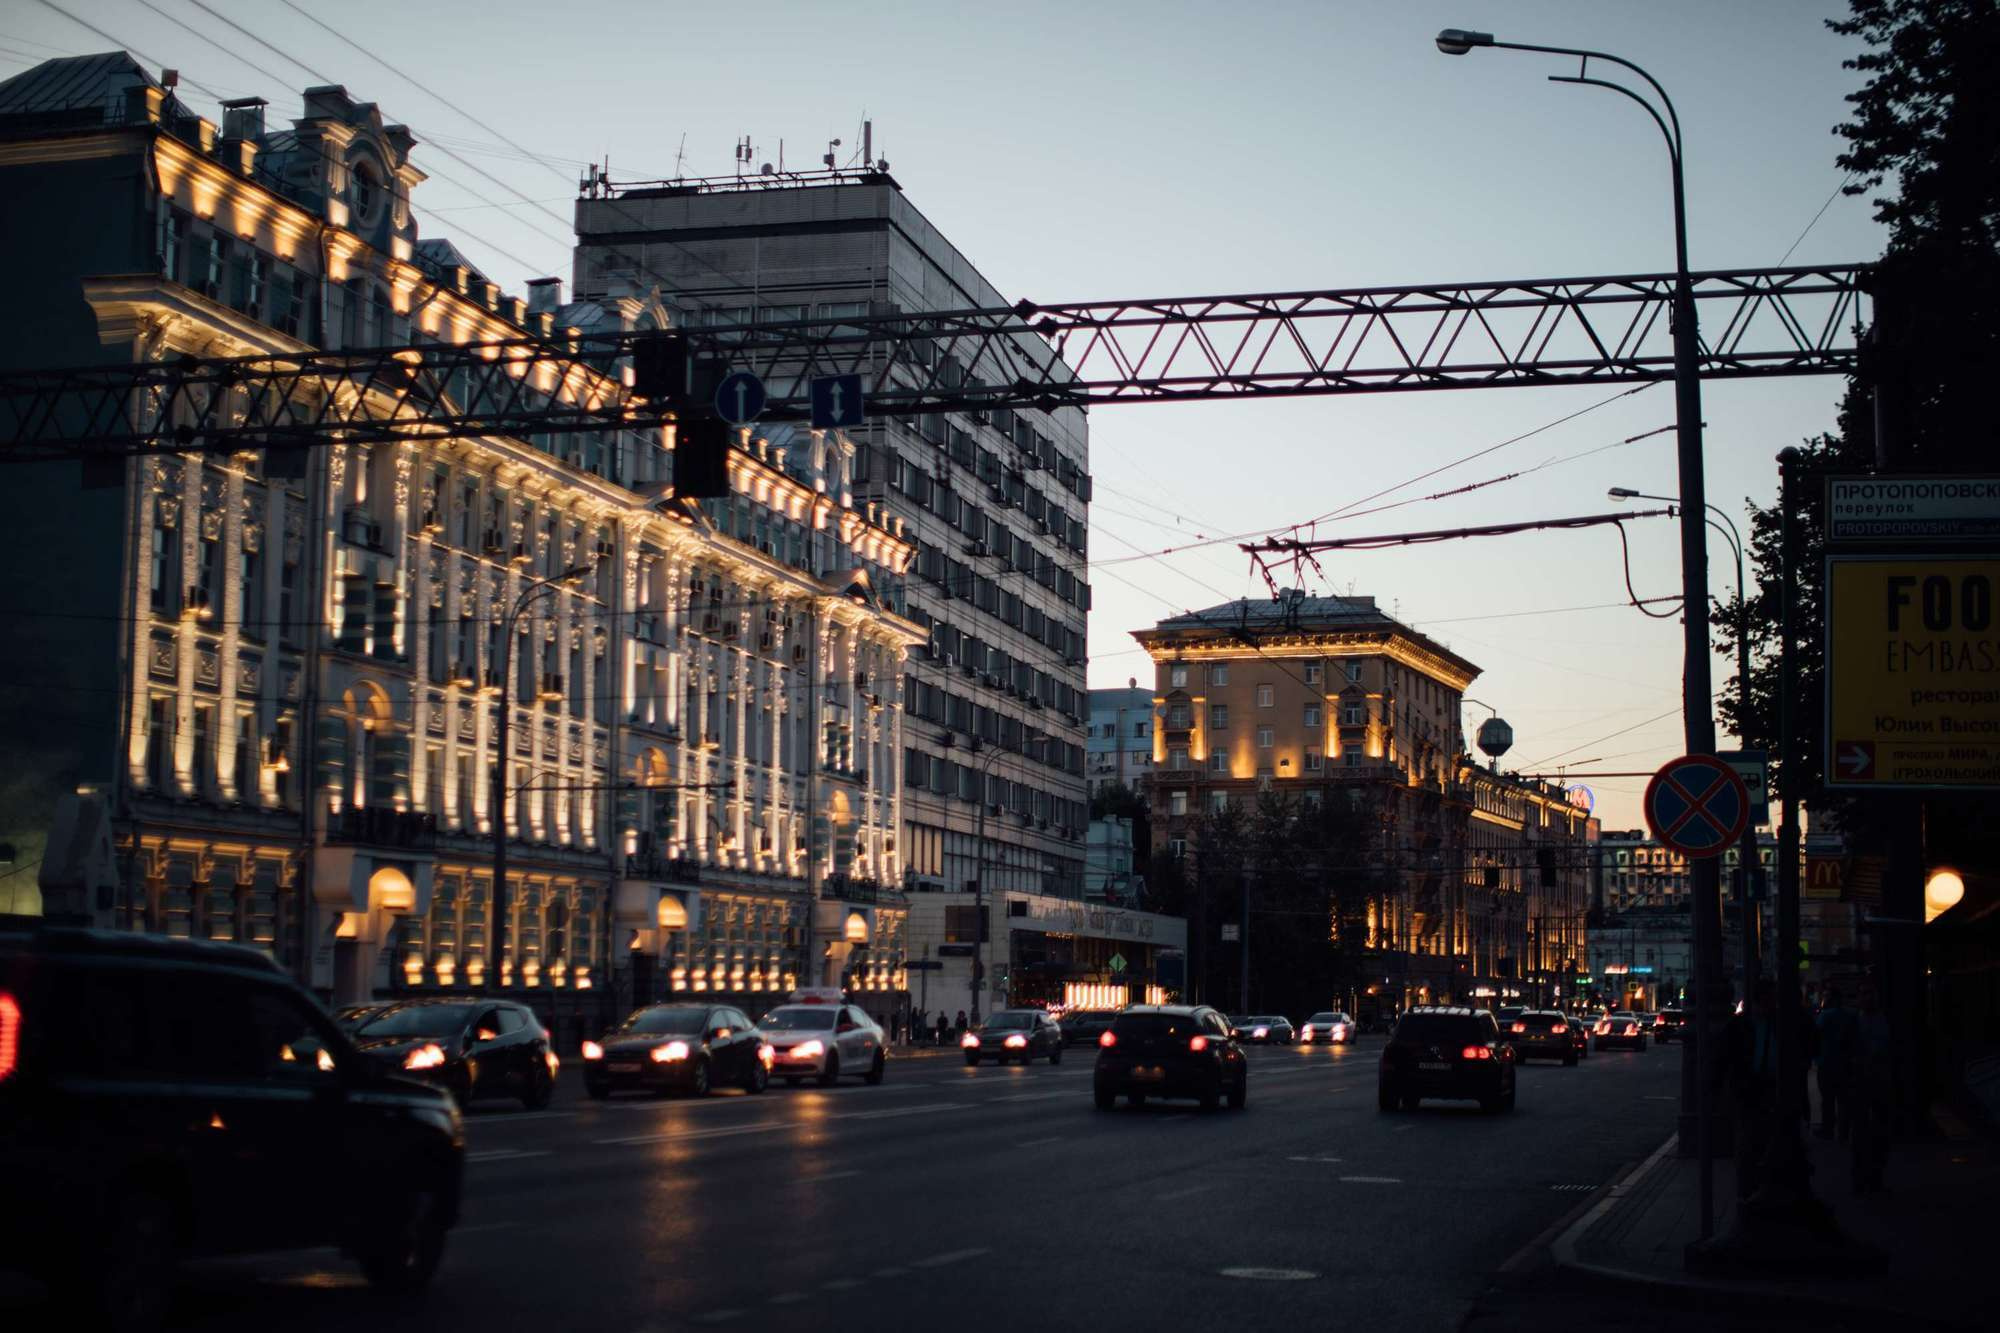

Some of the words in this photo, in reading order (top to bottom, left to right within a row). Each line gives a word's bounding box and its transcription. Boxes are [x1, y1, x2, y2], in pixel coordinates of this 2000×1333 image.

[1835, 483, 2000, 499] ПРОТОПОПОВСК
[1835, 503, 1915, 516] переулок
[1887, 639, 2000, 673] EMBAS
[1875, 714, 1934, 733] Юлии
